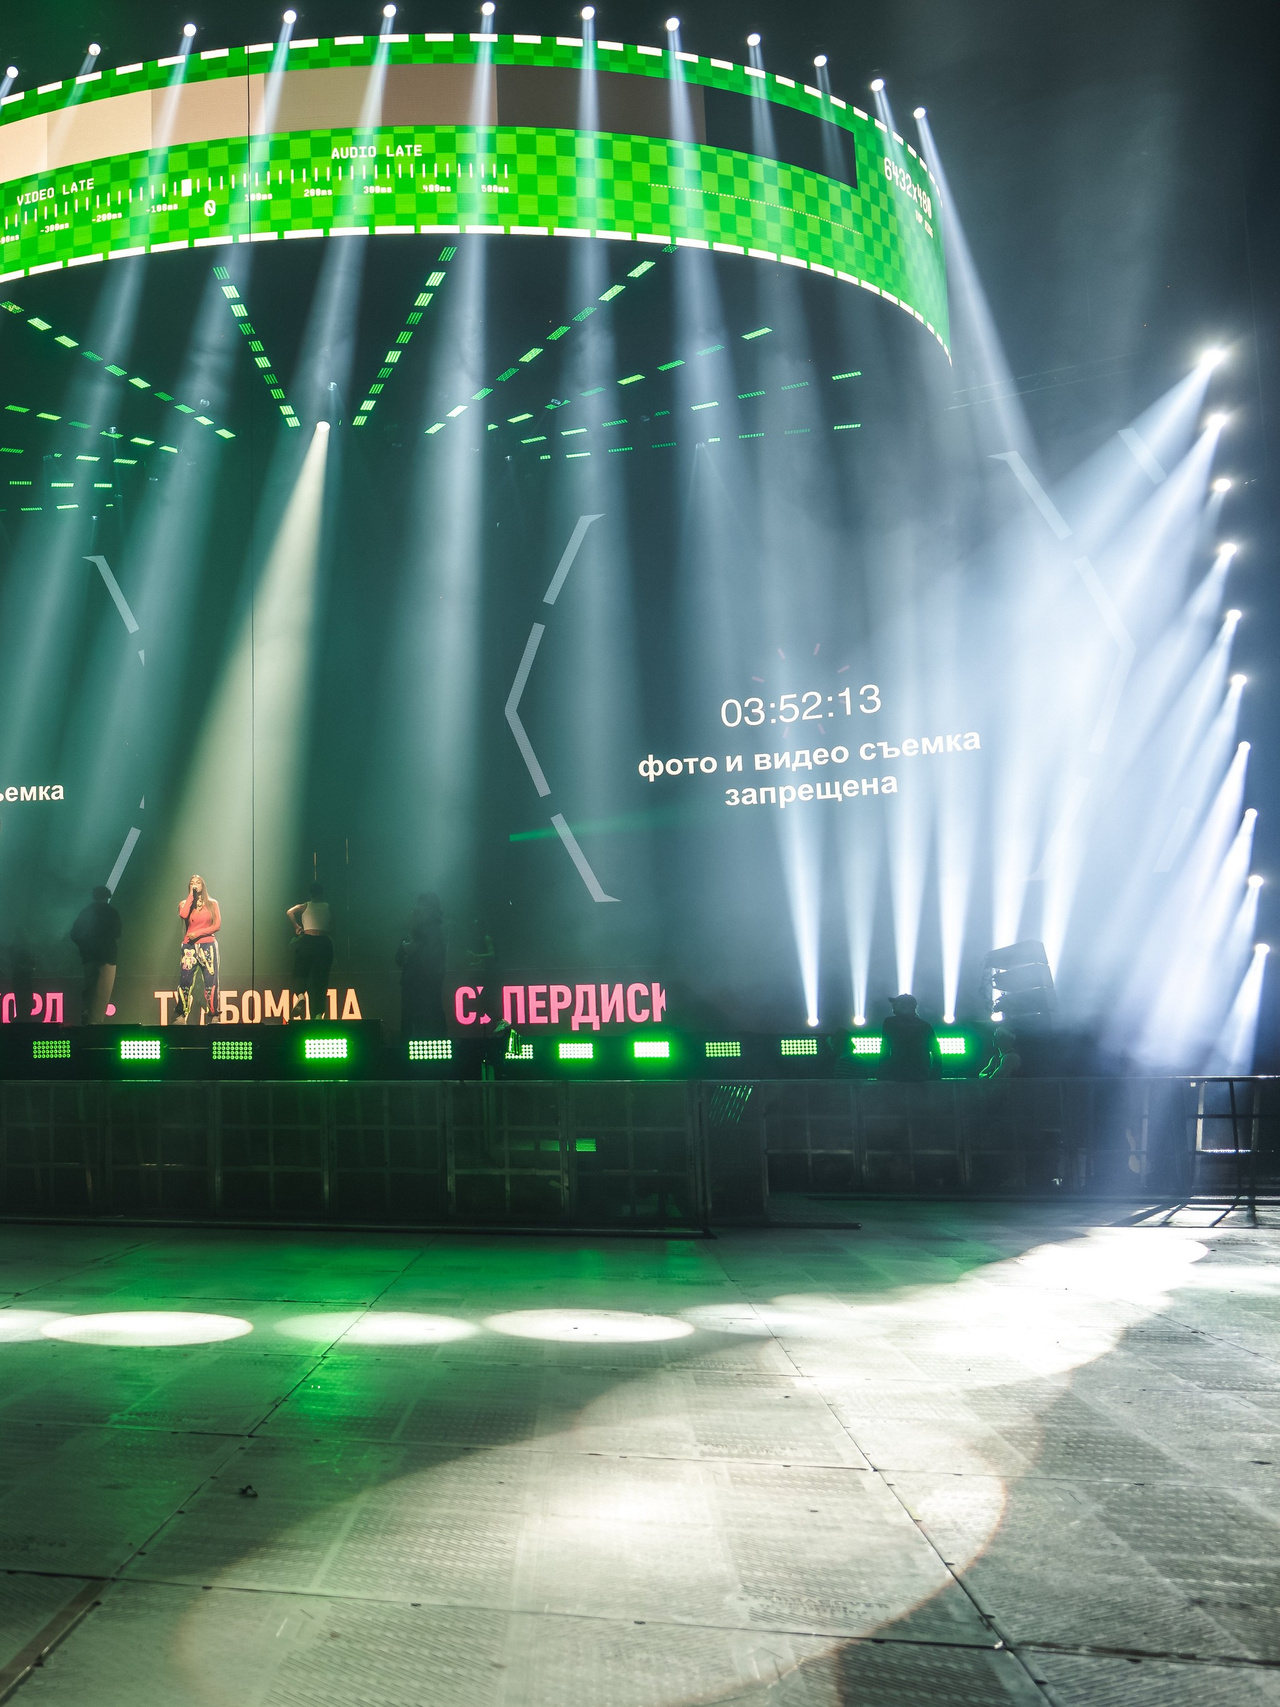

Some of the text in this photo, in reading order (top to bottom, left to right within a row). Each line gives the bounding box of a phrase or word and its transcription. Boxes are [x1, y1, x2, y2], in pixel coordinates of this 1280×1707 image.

[331, 144, 422, 160] AUDIO LATE
[17, 178, 94, 206] VIDEO LATE
[884, 157, 932, 219] 6432x480
[721, 684, 882, 727] 03:52:13
[638, 731, 981, 782] фото и видео съемка
[725, 775, 898, 808] запрещена
